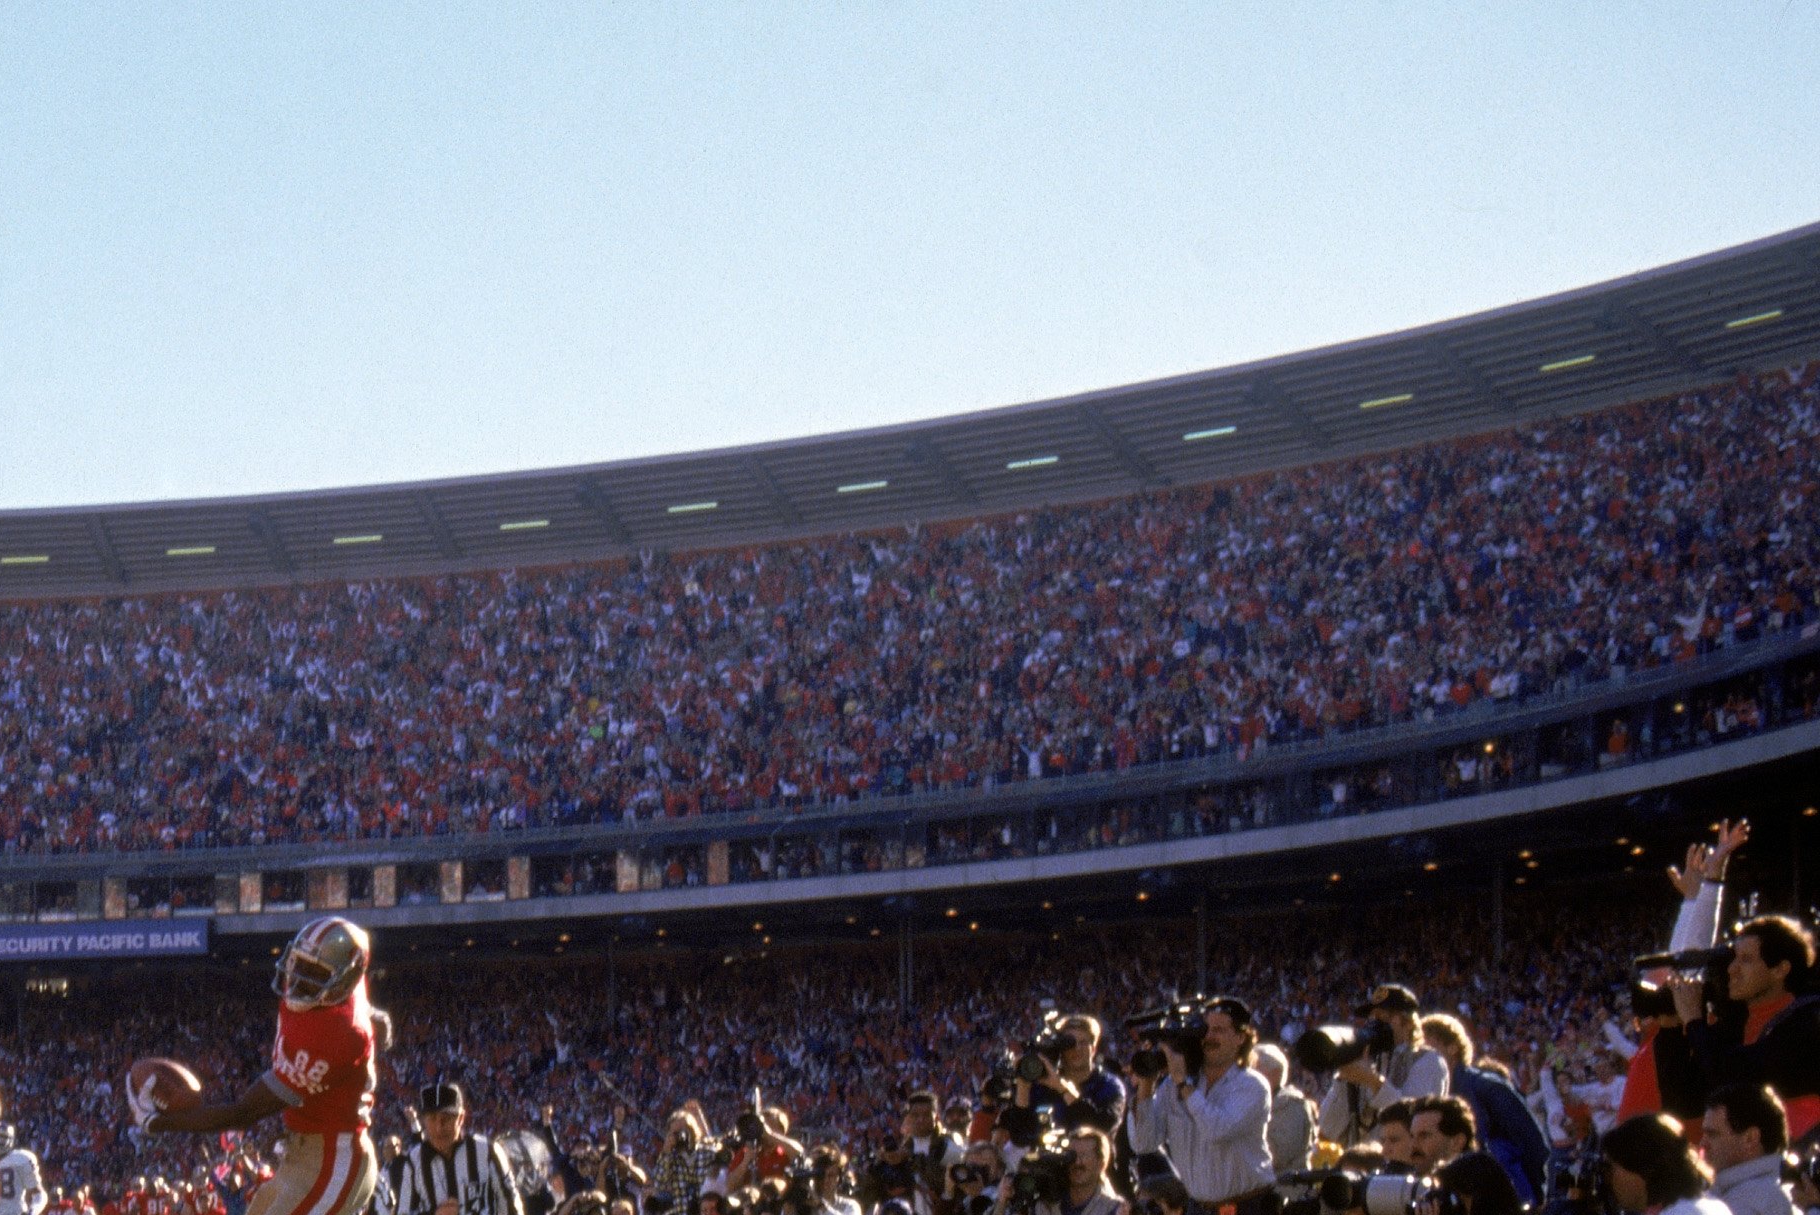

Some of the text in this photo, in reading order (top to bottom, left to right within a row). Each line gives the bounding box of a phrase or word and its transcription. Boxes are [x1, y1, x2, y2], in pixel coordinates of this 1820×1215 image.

[76, 932, 145, 953] PACIFIC
[148, 930, 202, 949] BANK
[0, 1166, 15, 1199] 8
